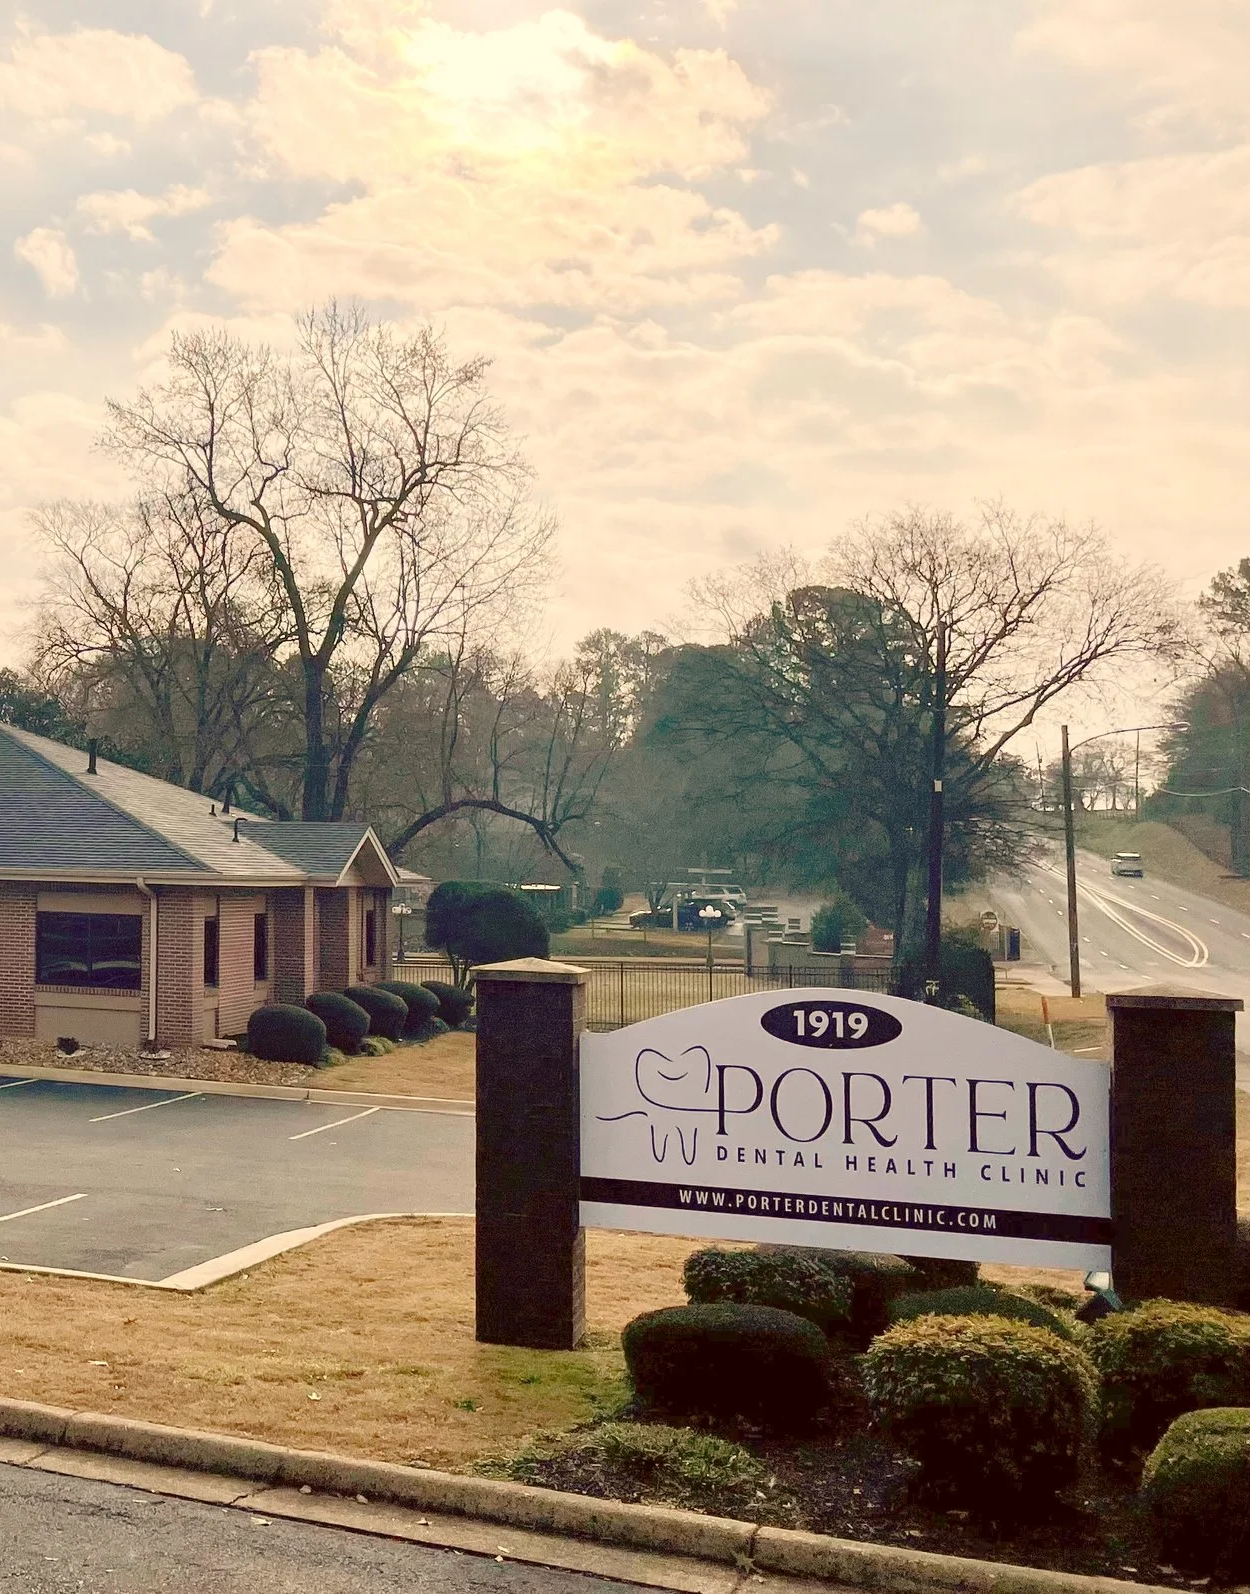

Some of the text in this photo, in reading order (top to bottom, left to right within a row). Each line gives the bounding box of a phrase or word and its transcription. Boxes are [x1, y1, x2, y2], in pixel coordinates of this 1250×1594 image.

[792, 1009, 869, 1040] 1919
[716, 1065, 1087, 1160] PORTER
[717, 1146, 1087, 1188] DENTAL HEALTH CLINIC
[679, 1189, 997, 1230] WWW.PORTERDENTALCLINIC.COM
